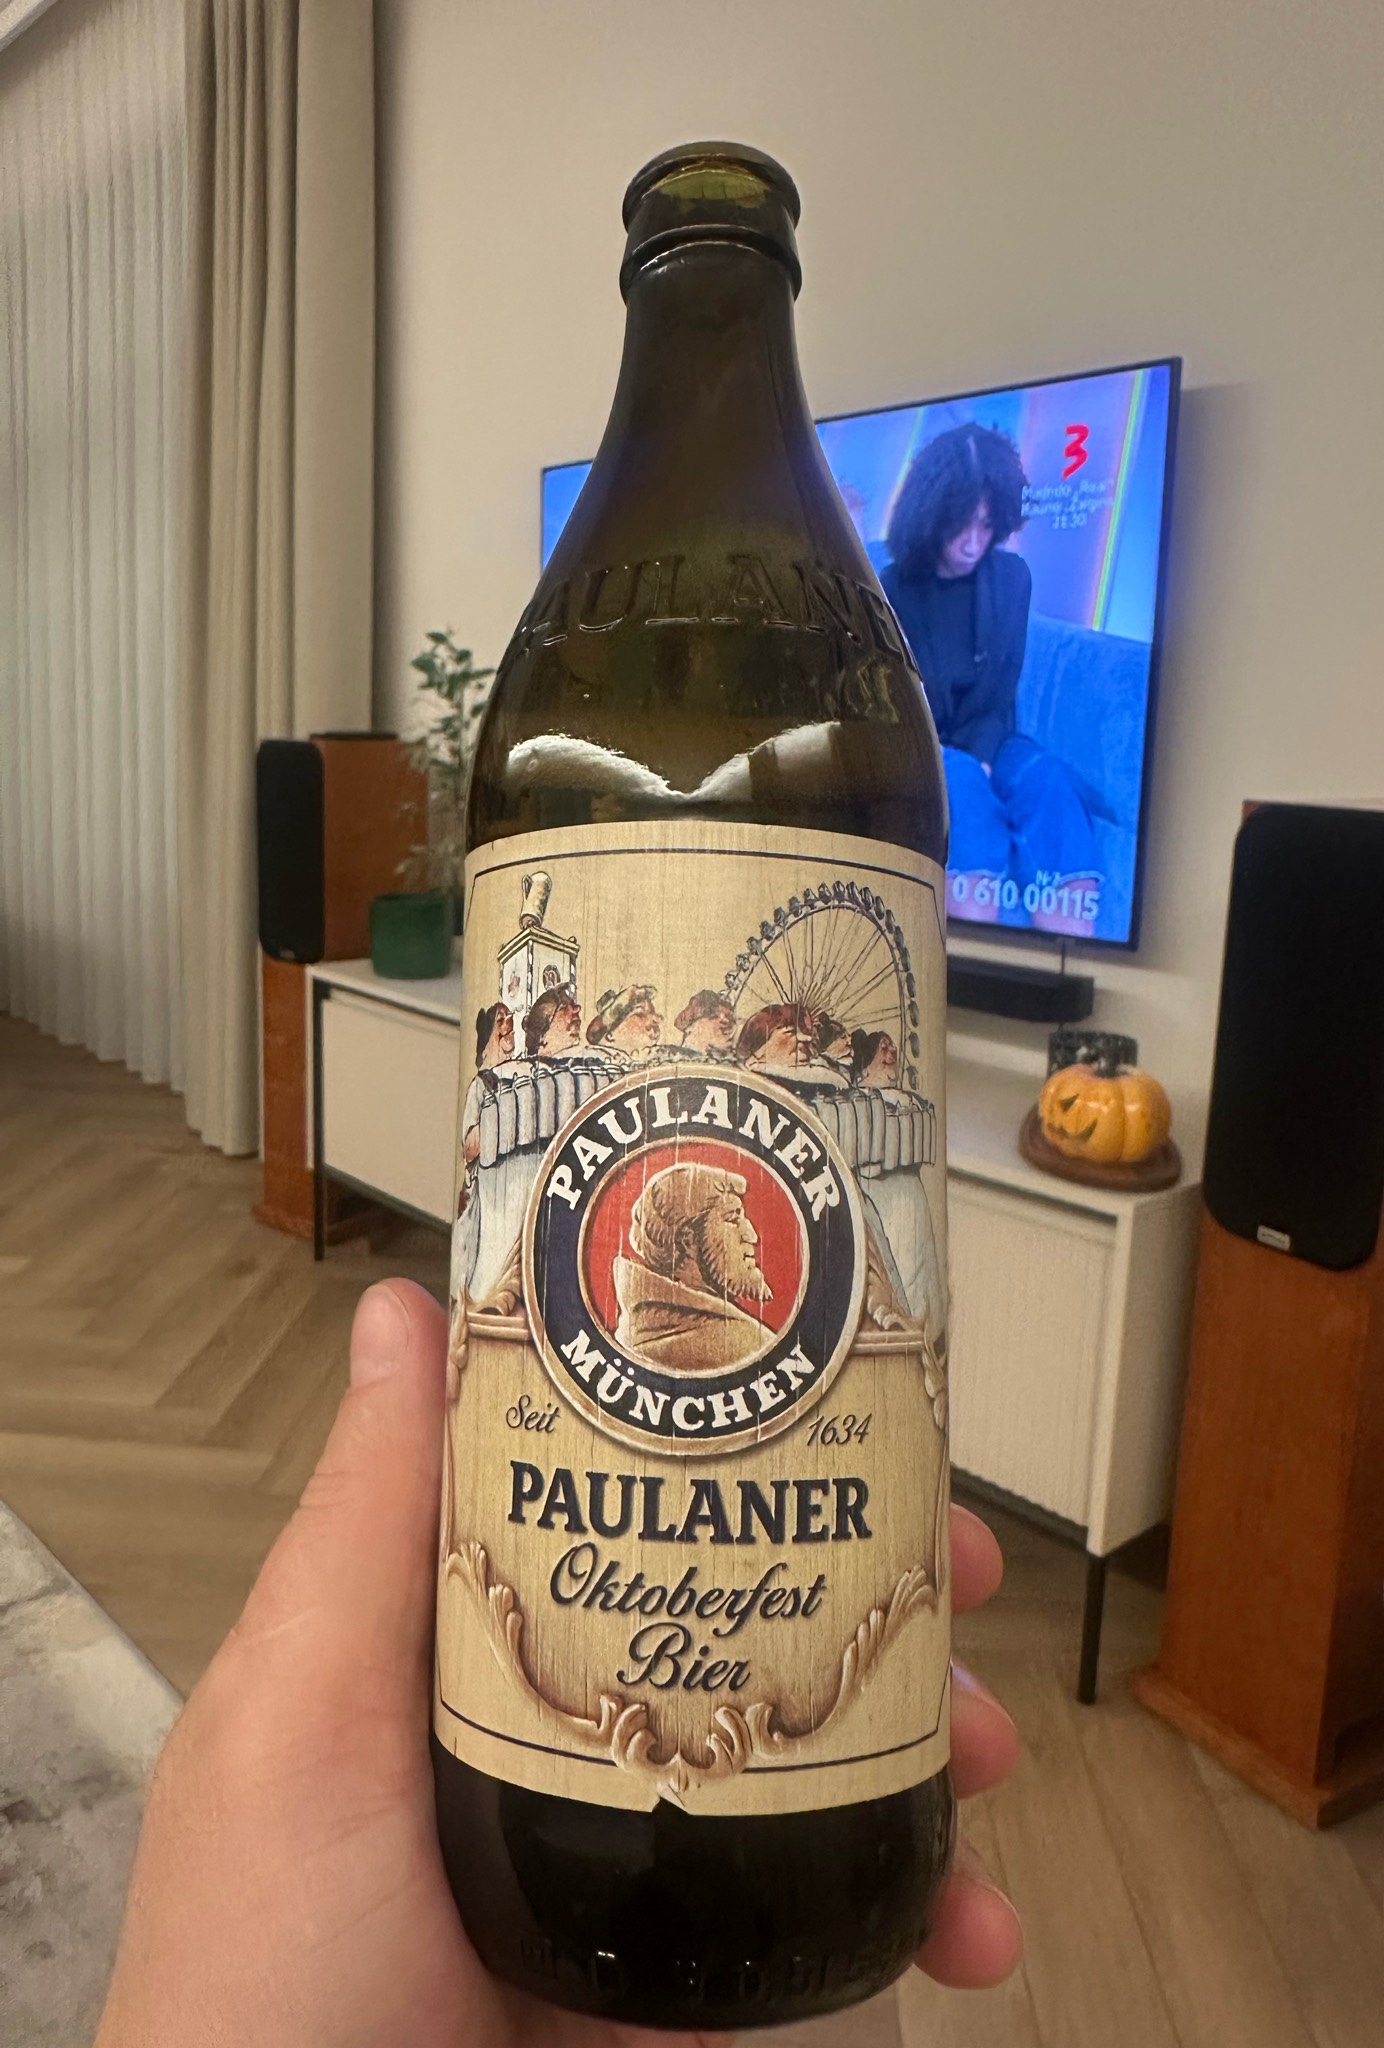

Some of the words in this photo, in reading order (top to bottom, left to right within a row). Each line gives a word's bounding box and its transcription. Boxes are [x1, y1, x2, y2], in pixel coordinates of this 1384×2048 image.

[1062, 423, 1090, 480] 3
[973, 878, 1018, 909] 610
[1023, 883, 1100, 921] 00115
[547, 1085, 841, 1222] PAULANER
[560, 1329, 817, 1431] MÜNCHEN
[505, 1394, 560, 1435] Seit
[805, 1413, 873, 1447] 1634
[507, 1460, 873, 1545] PAULANER
[549, 1541, 827, 1638] Oktoberfest
[616, 1621, 752, 1692] Bier
